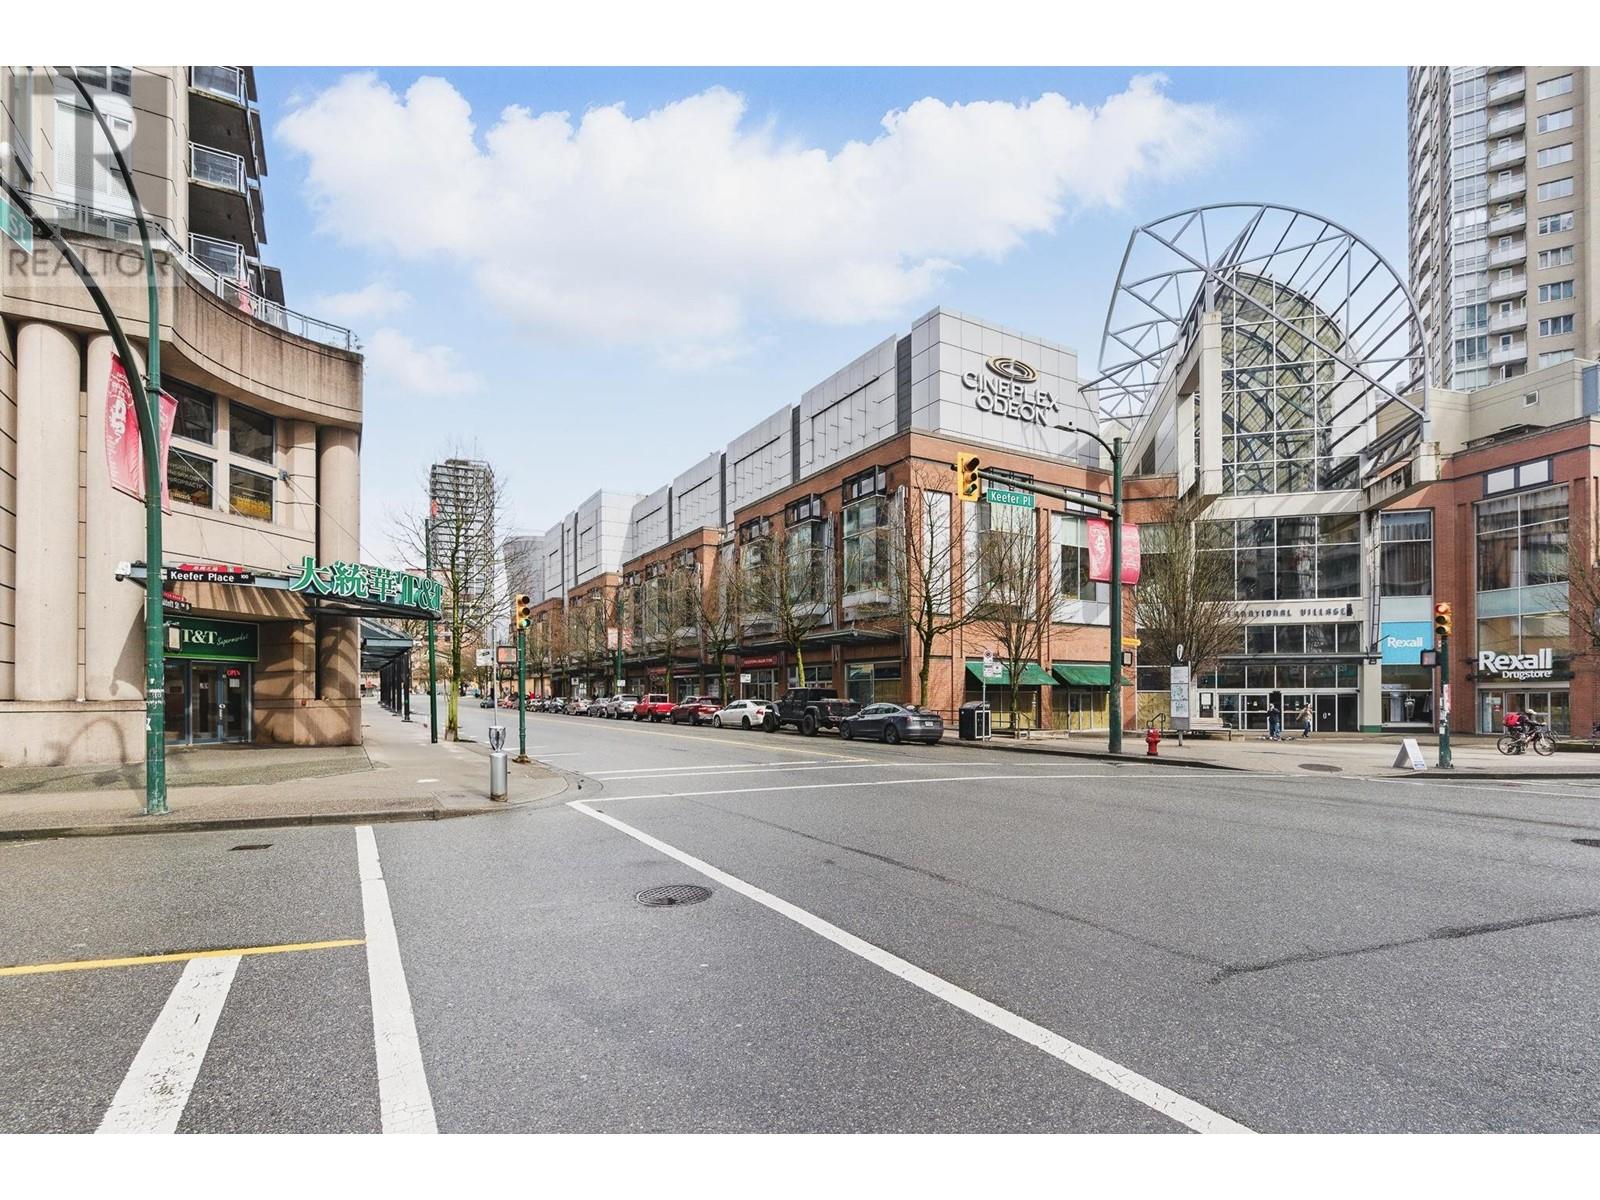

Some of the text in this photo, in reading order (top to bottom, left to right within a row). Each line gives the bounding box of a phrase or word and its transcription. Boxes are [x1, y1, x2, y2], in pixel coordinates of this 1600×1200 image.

[9, 213, 26, 244] St
[961, 371, 1060, 413] CINEPLEX
[975, 393, 1047, 427] ODEON
[991, 491, 1032, 507] Keefer Pl
[170, 571, 204, 581] Keefer
[208, 573, 235, 583] Place
[287, 555, 443, 611] 大統華 T&T
[181, 628, 218, 645] T&T
[1387, 636, 1423, 649] Rexall
[1478, 648, 1553, 673] Rexall
[1502, 669, 1553, 681] Drugstore
